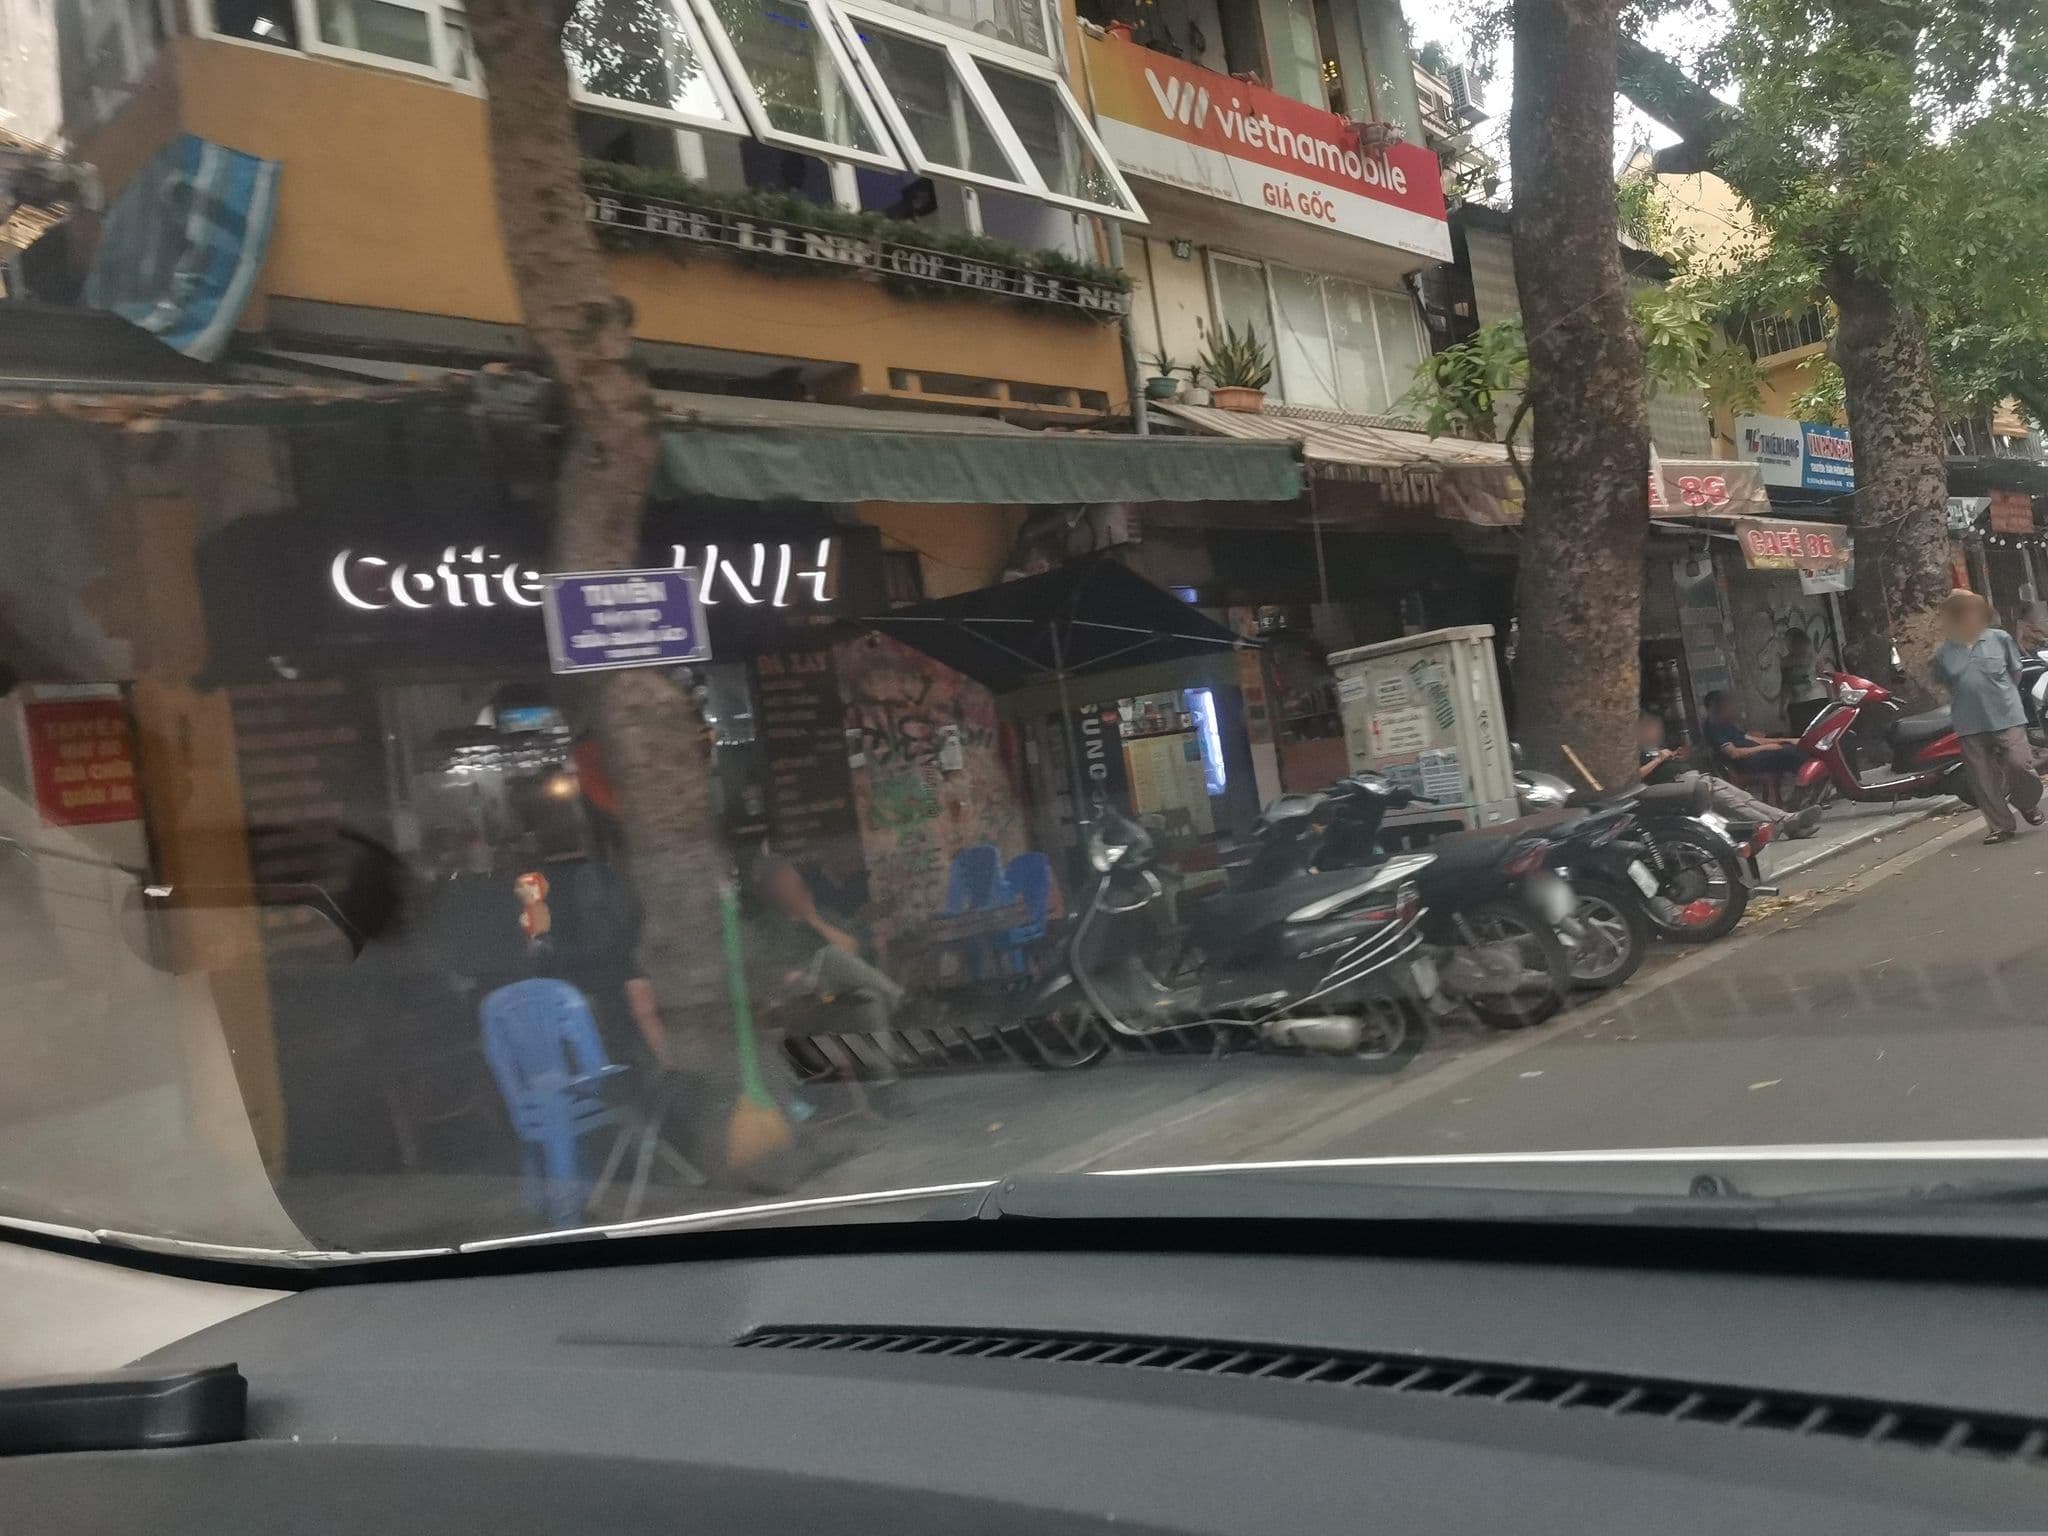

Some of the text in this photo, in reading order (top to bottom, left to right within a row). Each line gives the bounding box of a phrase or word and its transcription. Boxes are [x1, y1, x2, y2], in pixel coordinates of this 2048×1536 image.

[1214, 97, 1408, 195] vietnamobile
[1263, 181, 1336, 223] GIÁ GỐC
[1678, 475, 1731, 507] 86
[1748, 527, 1804, 558] CAFÉ
[331, 545, 544, 610] Coffe
